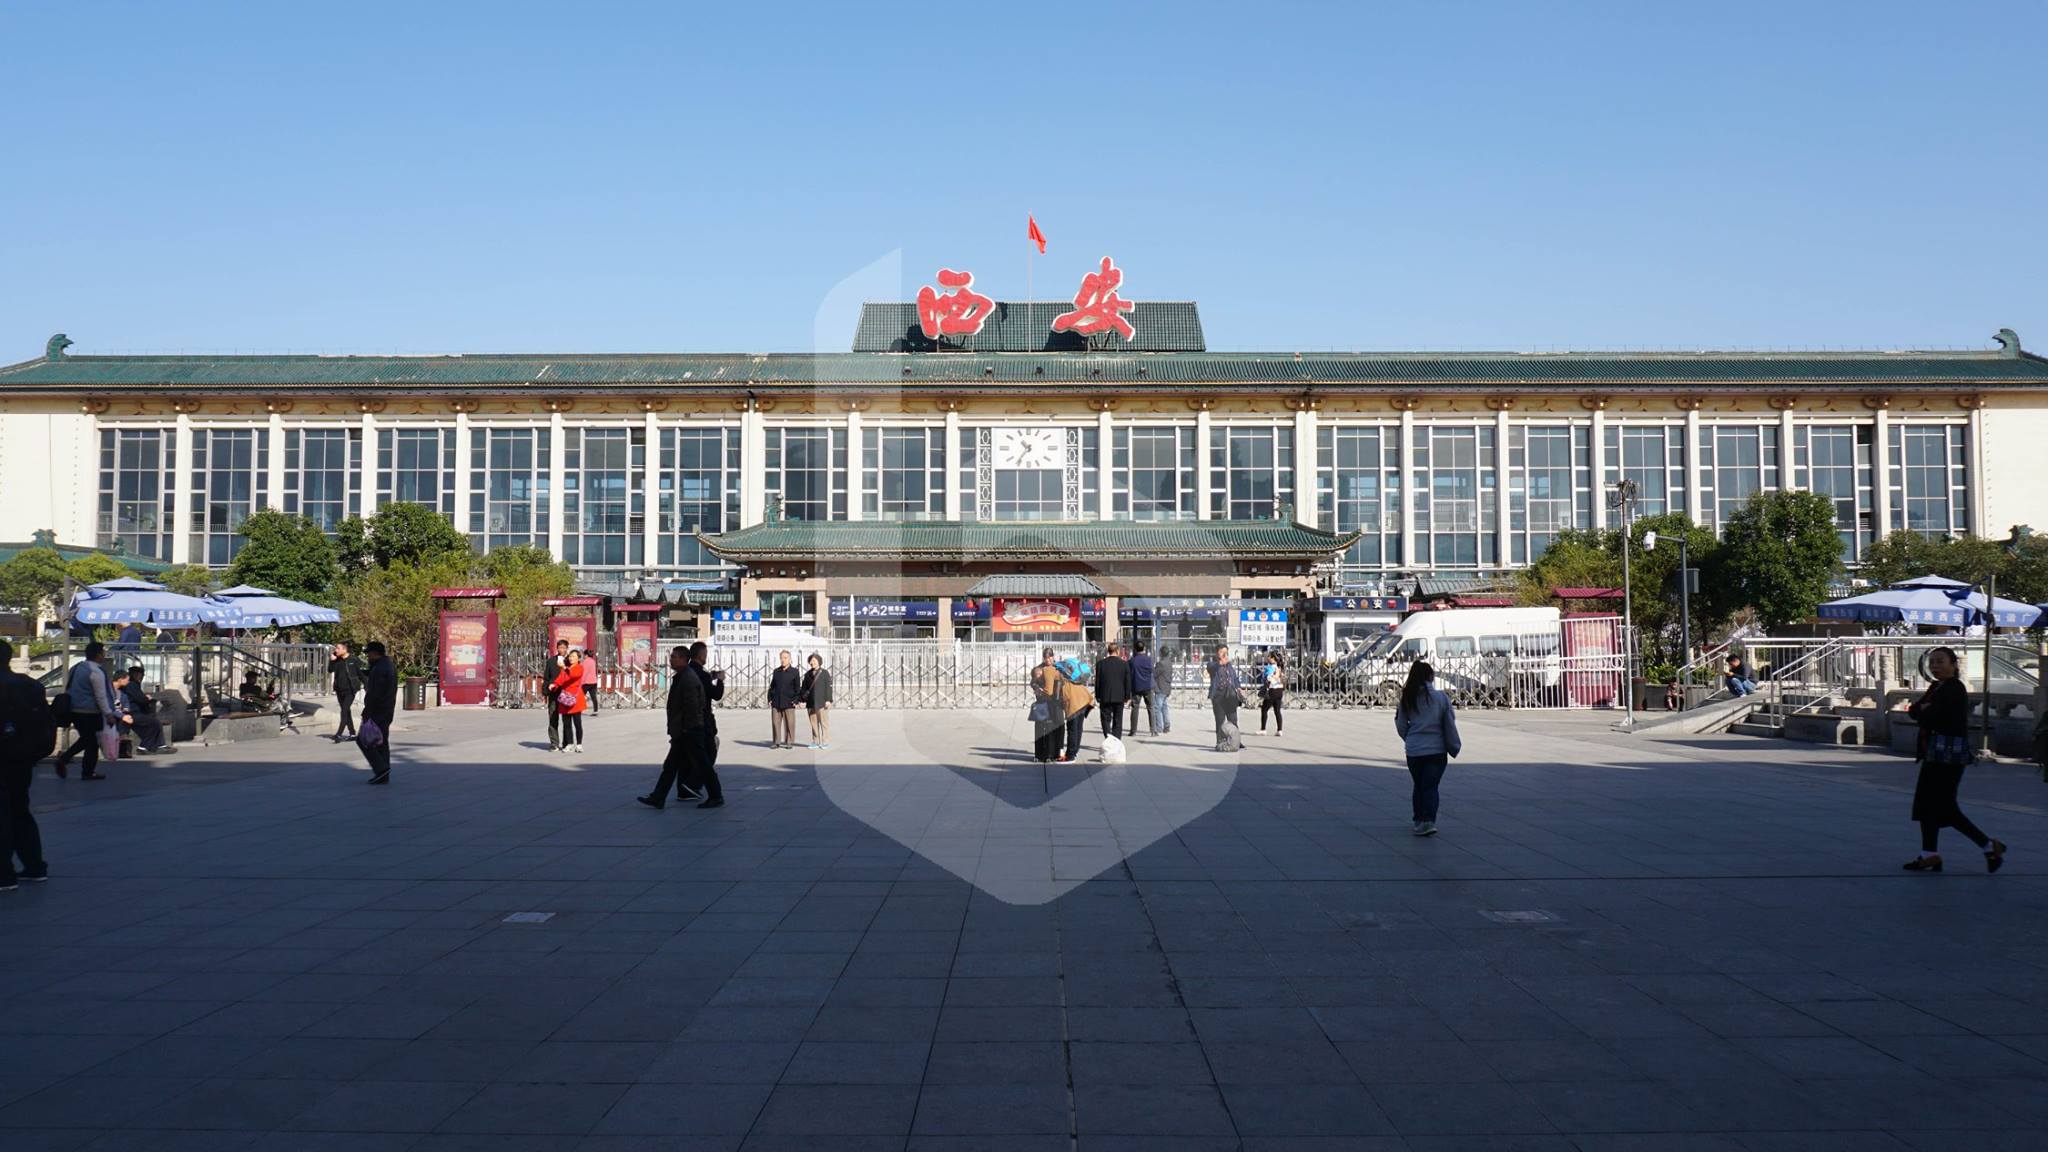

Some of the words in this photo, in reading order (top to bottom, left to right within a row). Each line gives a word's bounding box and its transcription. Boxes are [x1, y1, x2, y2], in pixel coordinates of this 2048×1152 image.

[916, 255, 1137, 343] 西安
[1347, 599, 1382, 609] 公安
[86, 609, 139, 621] 和谐广场
[721, 611, 753, 621] 警告
[880, 605, 887, 616] 2
[1247, 611, 1280, 621] 警告
[1909, 611, 1963, 623] 品质西安
